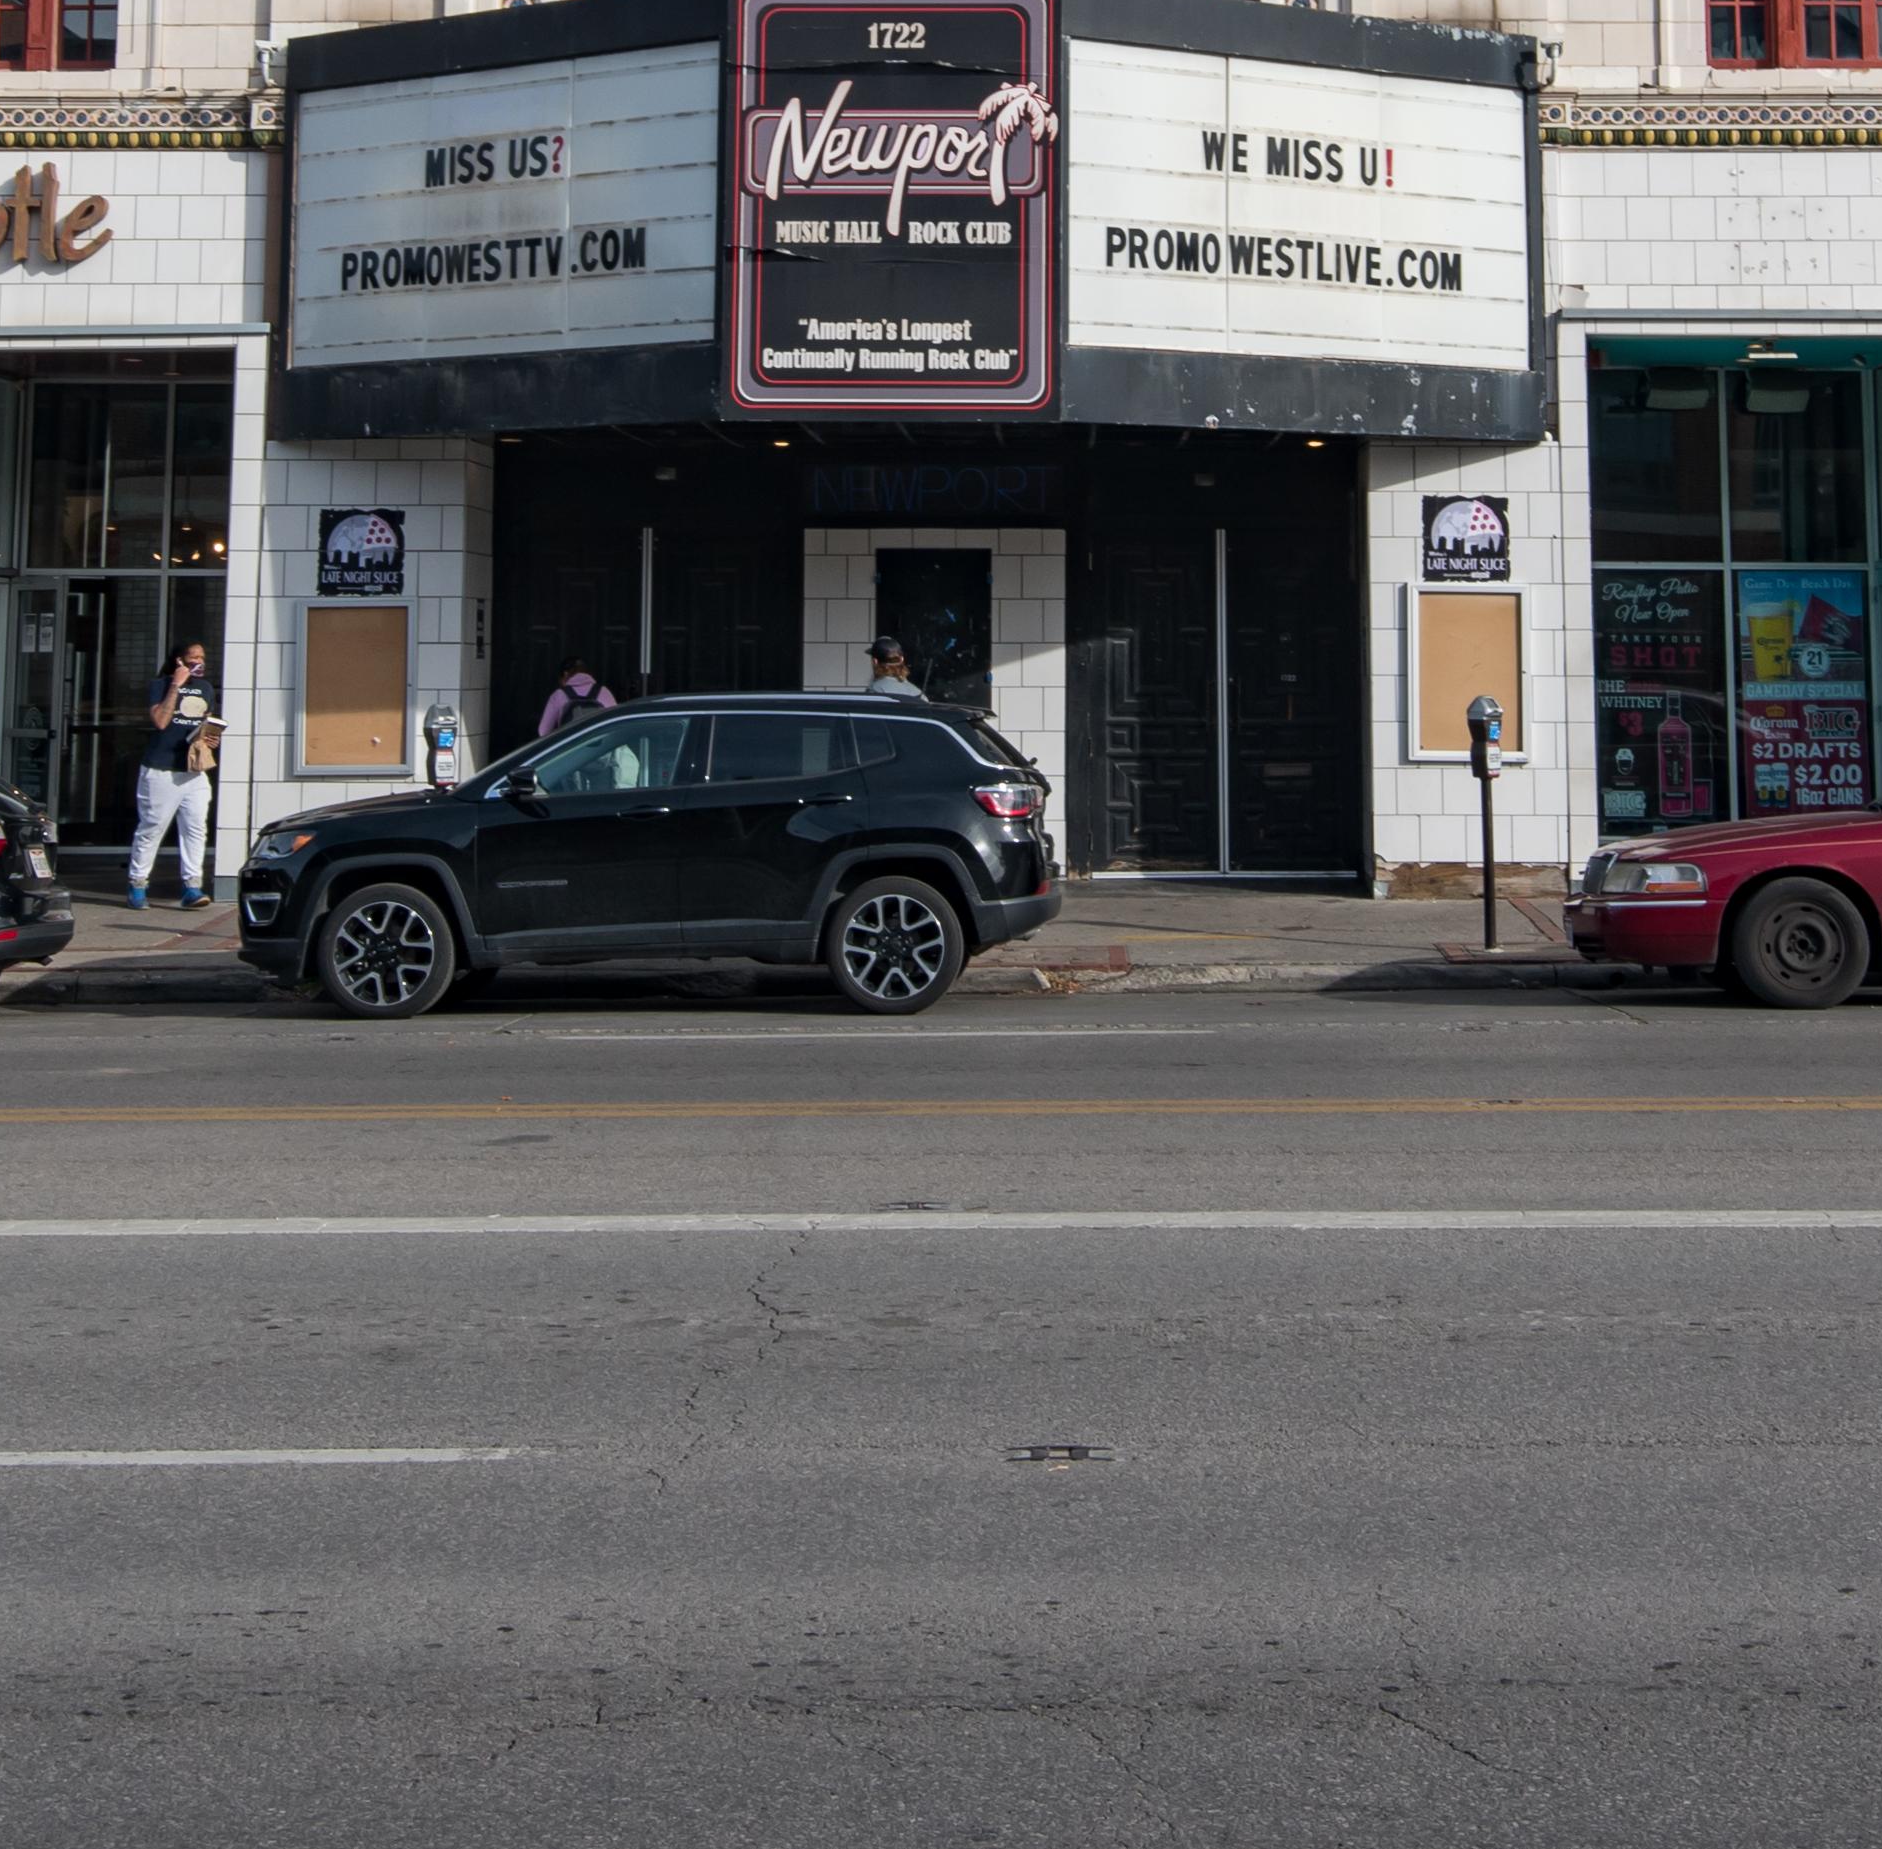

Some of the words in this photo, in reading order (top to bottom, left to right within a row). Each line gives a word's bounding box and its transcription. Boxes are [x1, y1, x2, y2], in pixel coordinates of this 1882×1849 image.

[867, 22, 927, 50] 1722
[425, 142, 495, 188] MISS
[507, 135, 565, 179] US?
[765, 80, 1053, 237] Newport
[1201, 130, 1248, 173] WE
[1266, 136, 1344, 183] MISS
[1360, 147, 1395, 188] U!
[775, 220, 830, 244] MUSIC
[834, 221, 882, 244] HALL
[908, 221, 961, 245] ROCK
[965, 221, 1012, 245] CLUB
[340, 226, 647, 292] PROMOWESTTV.COM
[1105, 226, 1462, 292] PROMOWESTLIVE.COM
[798, 318, 898, 342] "America's
[901, 318, 973, 344] Longest
[762, 348, 855, 372] Continually
[858, 349, 924, 372] Running
[928, 349, 970, 370] Rock
[974, 348, 1018, 370] Club"
[812, 465, 1060, 513] NEWPORT
[1426, 558, 1447, 570] LATE
[1449, 558, 1478, 570] NIGHT
[1479, 558, 1507, 571] SLICE
[321, 571, 341, 584] LATE
[343, 571, 372, 584] NIGHT
[373, 571, 399, 584] SLICE
[1744, 577, 1773, 589] Game
[1801, 577, 1830, 589] Beach
[1602, 582, 1657, 604] Rooftop
[1659, 578, 1701, 597] Patio
[1614, 604, 1654, 623] Now
[1655, 601, 1690, 623] Open
[1610, 634, 1652, 644] TAKE
[1659, 634, 1703, 644] YOUR
[1609, 645, 1703, 668] SHOT
[1806, 650, 1823, 666] 21
[1597, 679, 1626, 693] THE
[1745, 682, 1805, 698] GAMEDAY
[1807, 682, 1862, 698] SPECIAL
[1599, 696, 1663, 709] WHITNEY
[1618, 711, 1644, 736] $3
[1749, 715, 1799, 736] Corona
[1802, 708, 1862, 733] BIG
[1752, 741, 1775, 760] $2
[1777, 741, 1862, 759] DRAFTS
[1794, 763, 1863, 785] $2.00
[1795, 786, 1826, 805] 16oz
[1827, 786, 1864, 805] CANS
